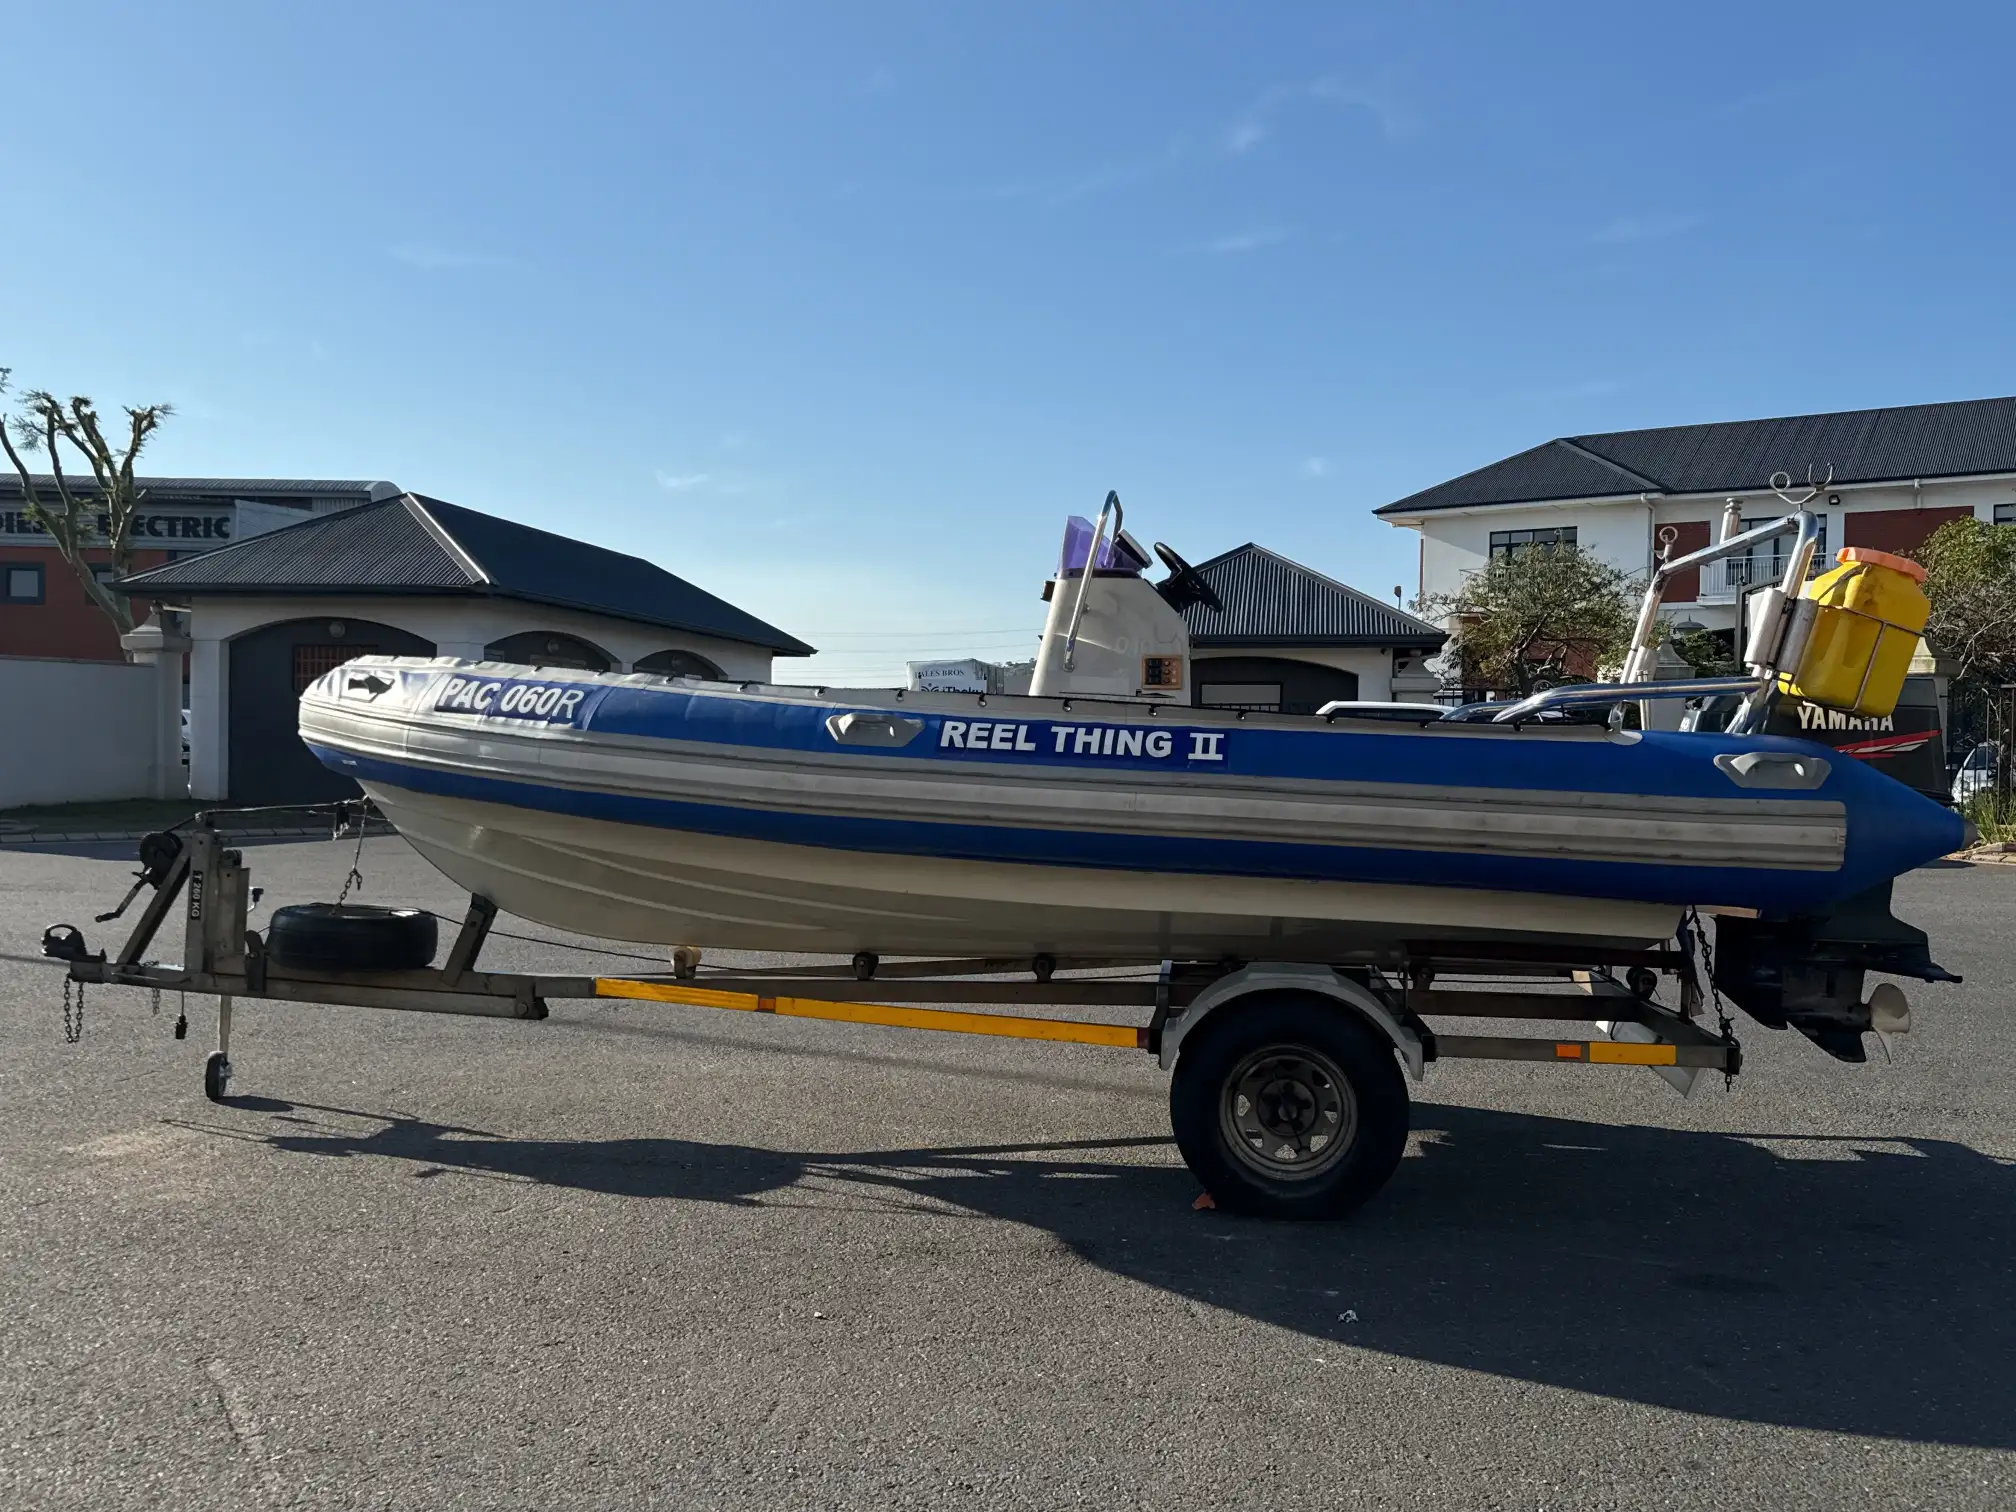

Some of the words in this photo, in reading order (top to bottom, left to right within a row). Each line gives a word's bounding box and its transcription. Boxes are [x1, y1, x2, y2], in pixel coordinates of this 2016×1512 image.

[98, 514, 231, 539] EECTRIC
[942, 669, 965, 677] BROS
[438, 678, 501, 710] PAC
[501, 684, 585, 719] 060R
[1797, 706, 1894, 731] YAMAHA
[940, 720, 1036, 752] REEL
[1051, 726, 1172, 758] THING
[1188, 733, 1225, 761] II
[191, 902, 200, 917] KG
